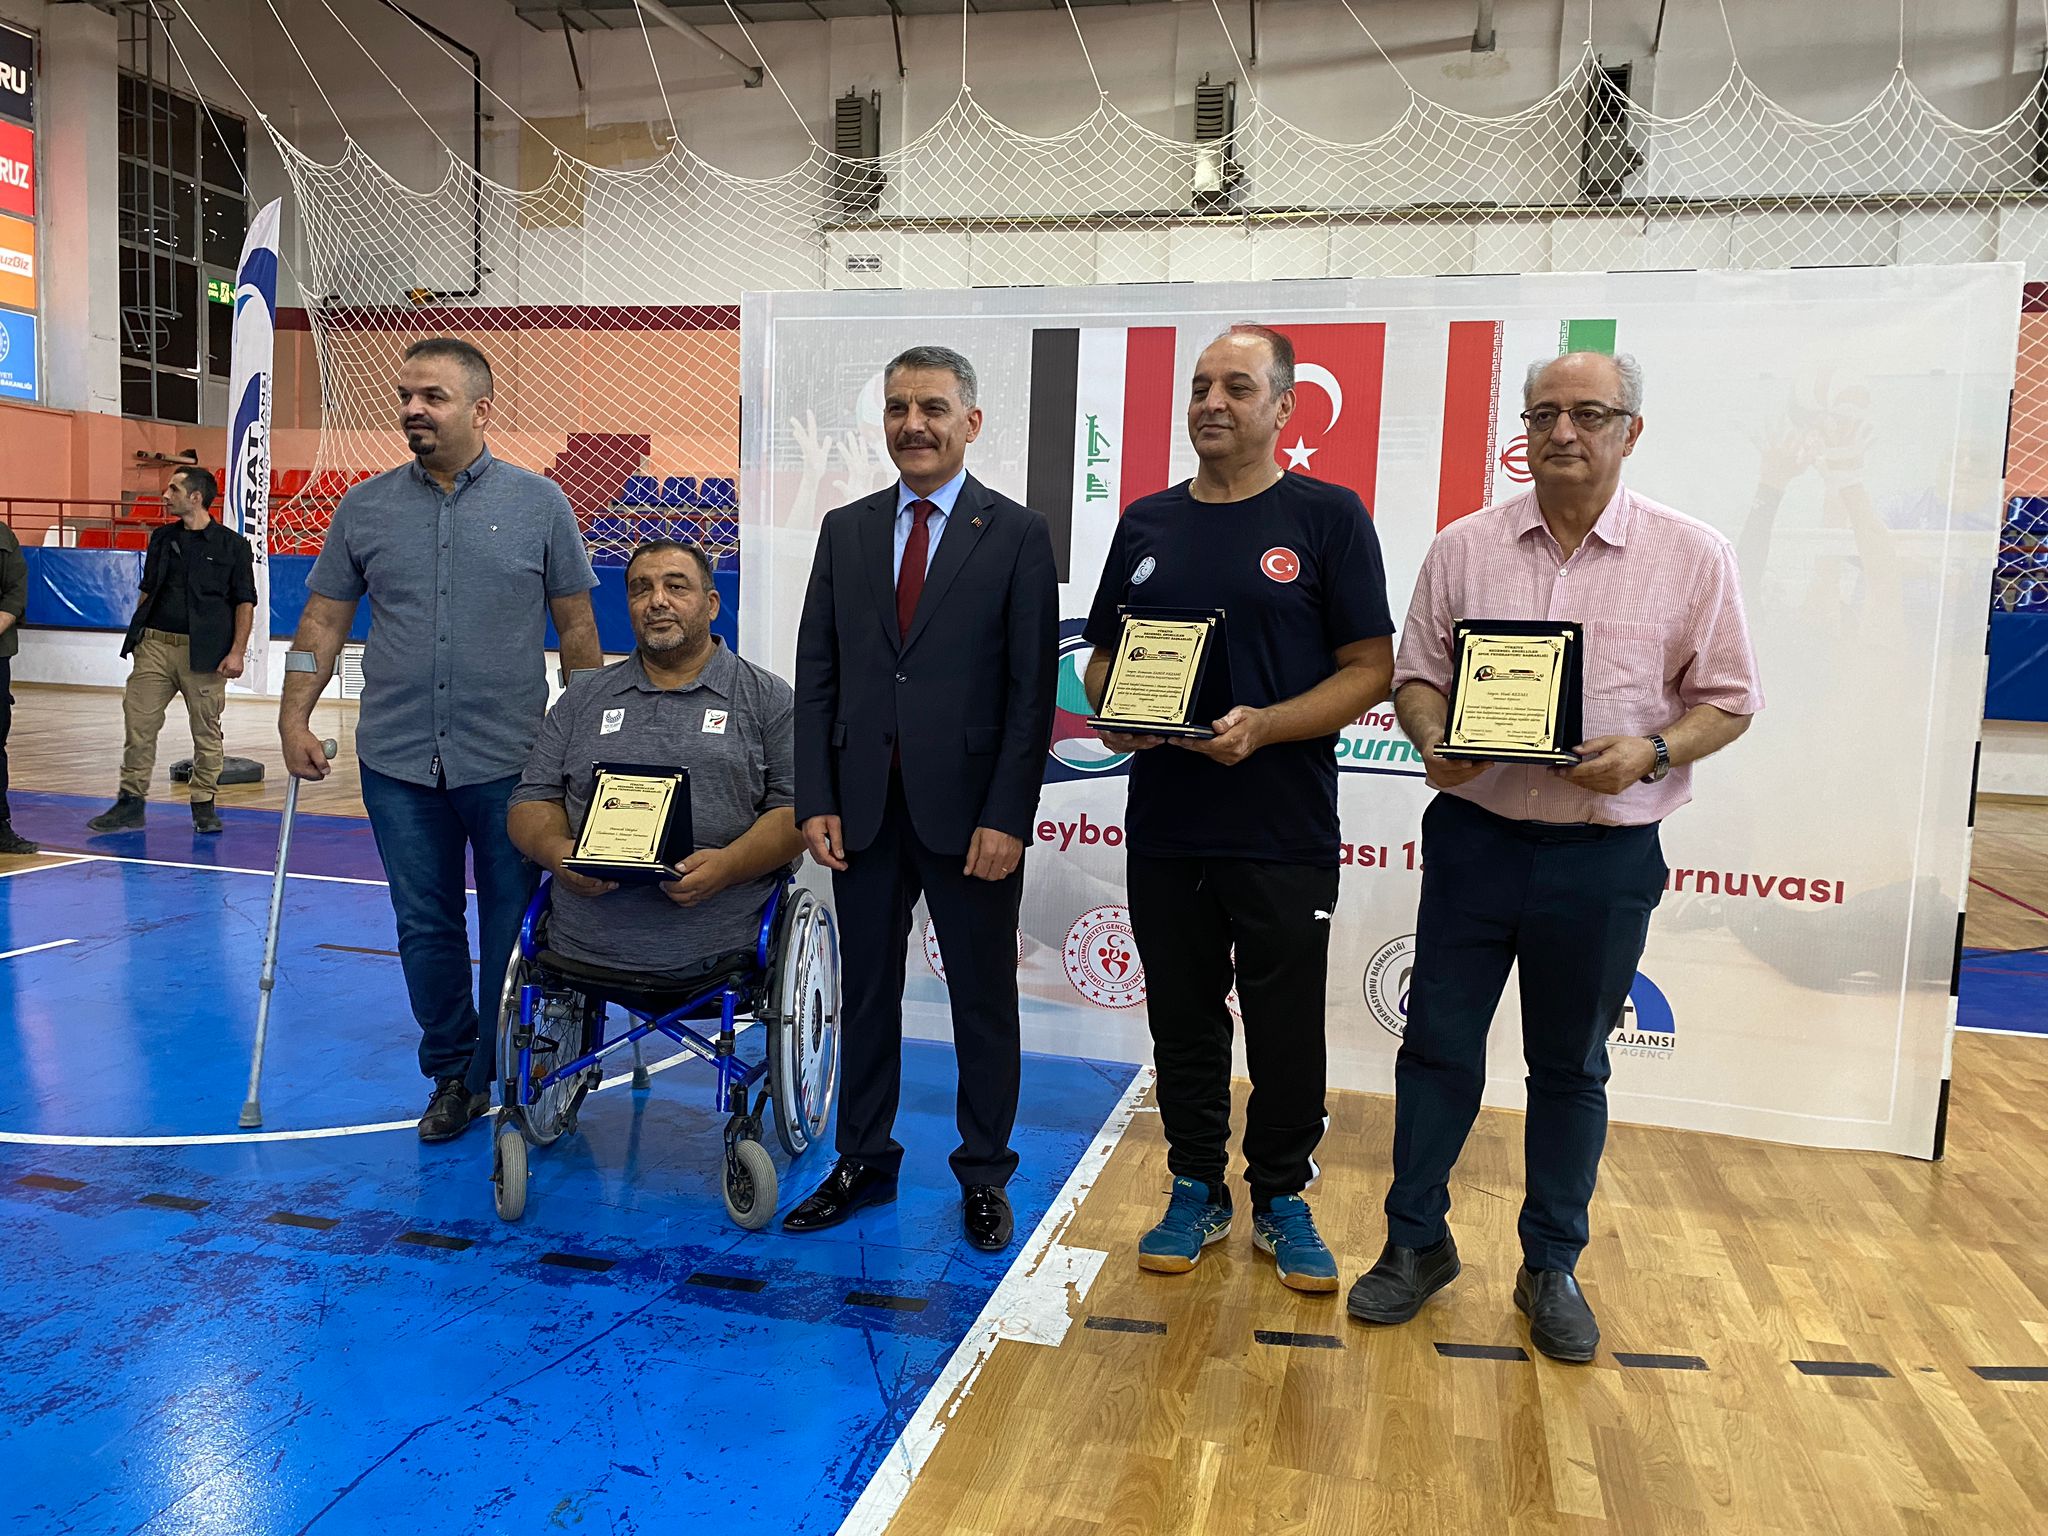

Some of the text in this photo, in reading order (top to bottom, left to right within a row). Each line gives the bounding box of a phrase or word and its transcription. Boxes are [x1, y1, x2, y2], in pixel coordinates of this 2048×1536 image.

[0, 61, 26, 94] RU
[0, 156, 29, 189] RUZ
[244, 426, 258, 542] IRAT
[256, 457, 264, 565] KALKINMA
[1351, 712, 1396, 731] ing
[1037, 813, 1123, 852] eybo
[1664, 868, 1845, 904] rnuvası
[1369, 941, 1406, 1029] FEDERASYONU BAŞKANLIĞI
[1616, 1032, 1675, 1047] AJANSI
[1620, 1048, 1674, 1060] AGENCY
